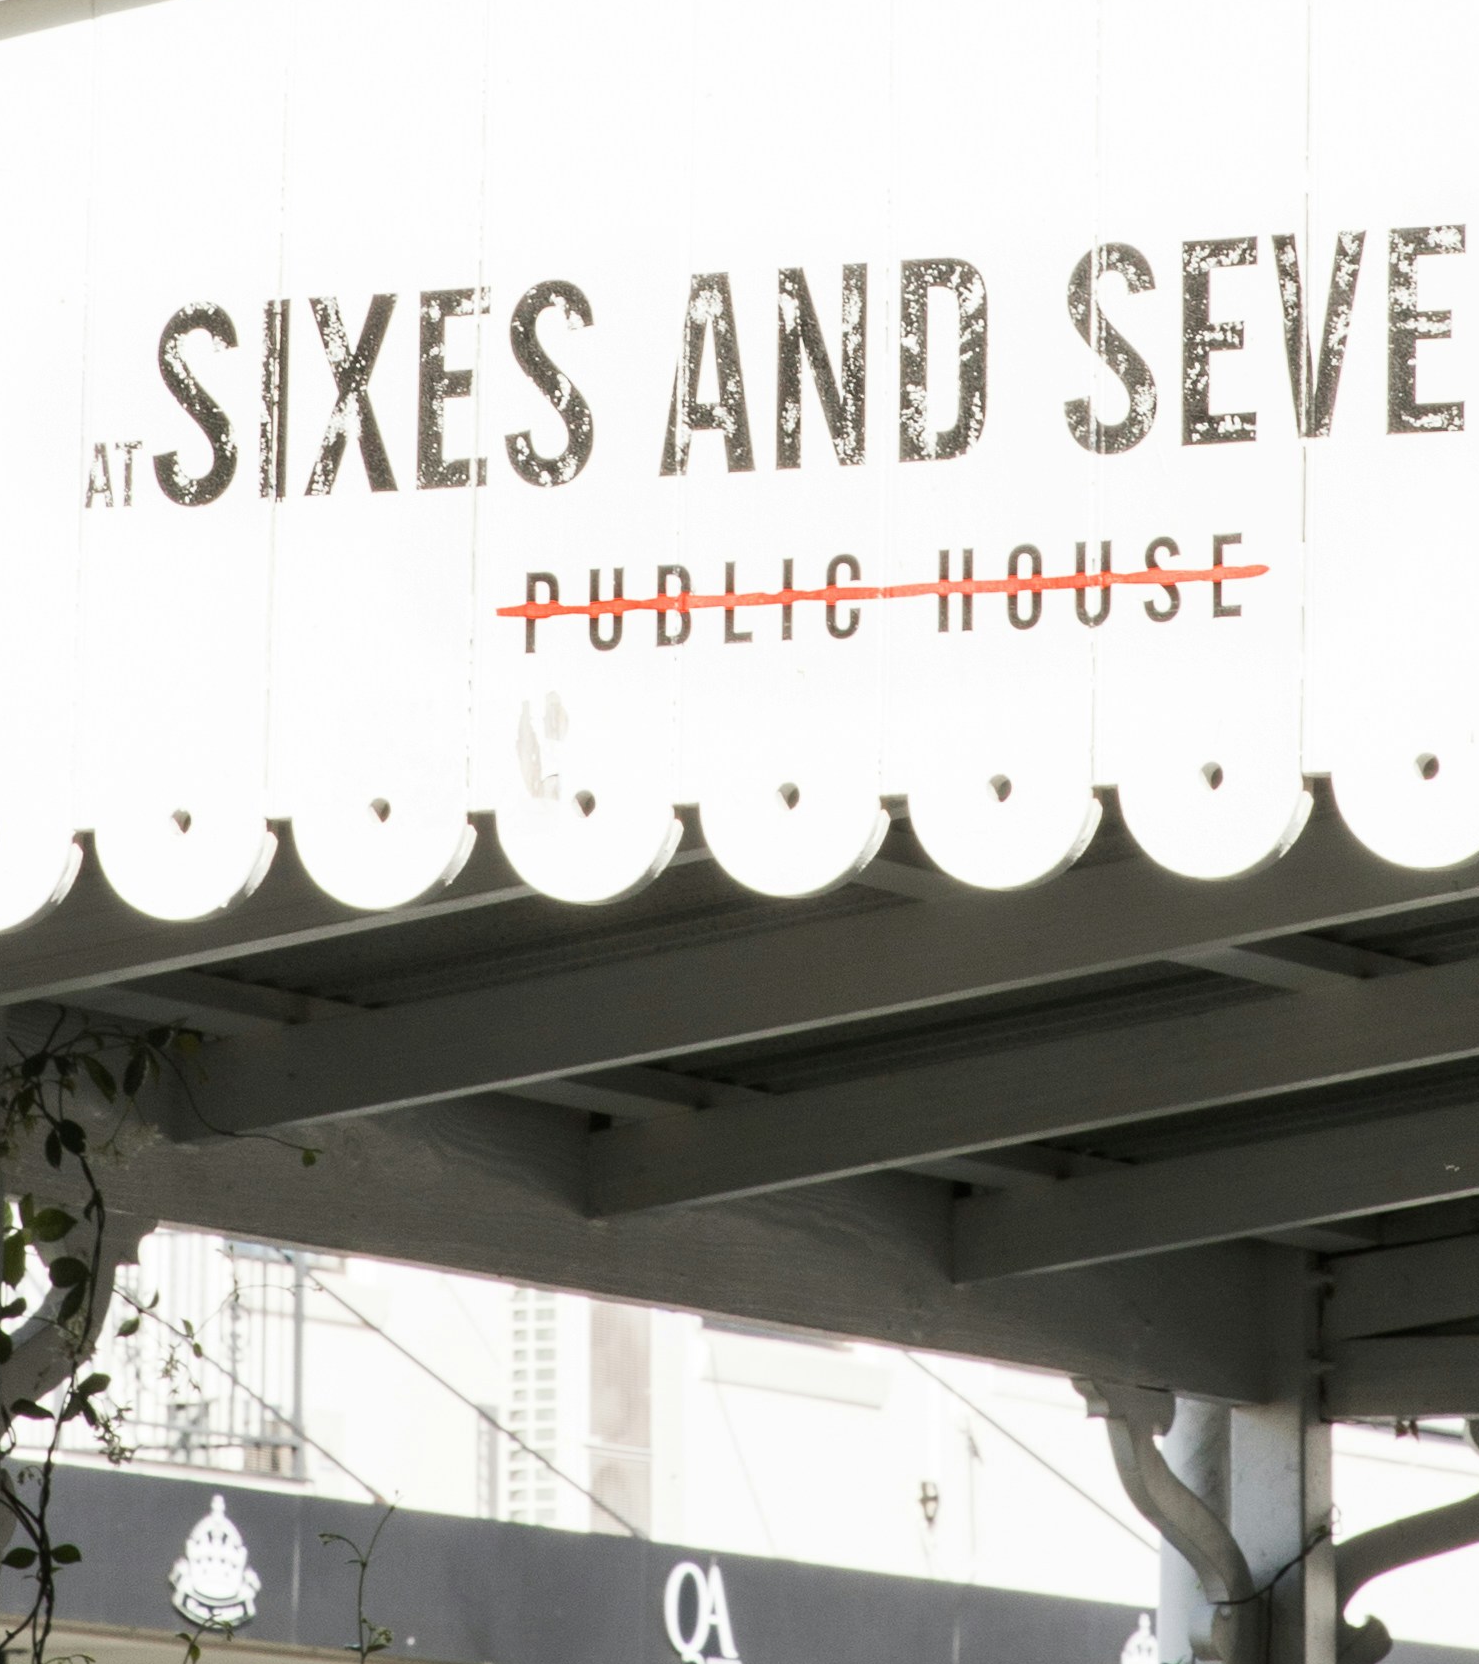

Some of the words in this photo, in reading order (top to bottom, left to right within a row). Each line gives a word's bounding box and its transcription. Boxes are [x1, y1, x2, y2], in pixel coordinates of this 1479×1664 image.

[84, 439, 144, 509] AT
[152, 278, 595, 507] SIXES
[658, 257, 989, 477] AND
[524, 553, 863, 654] PUBLIC
[937, 532, 1243, 634] HOUSE
